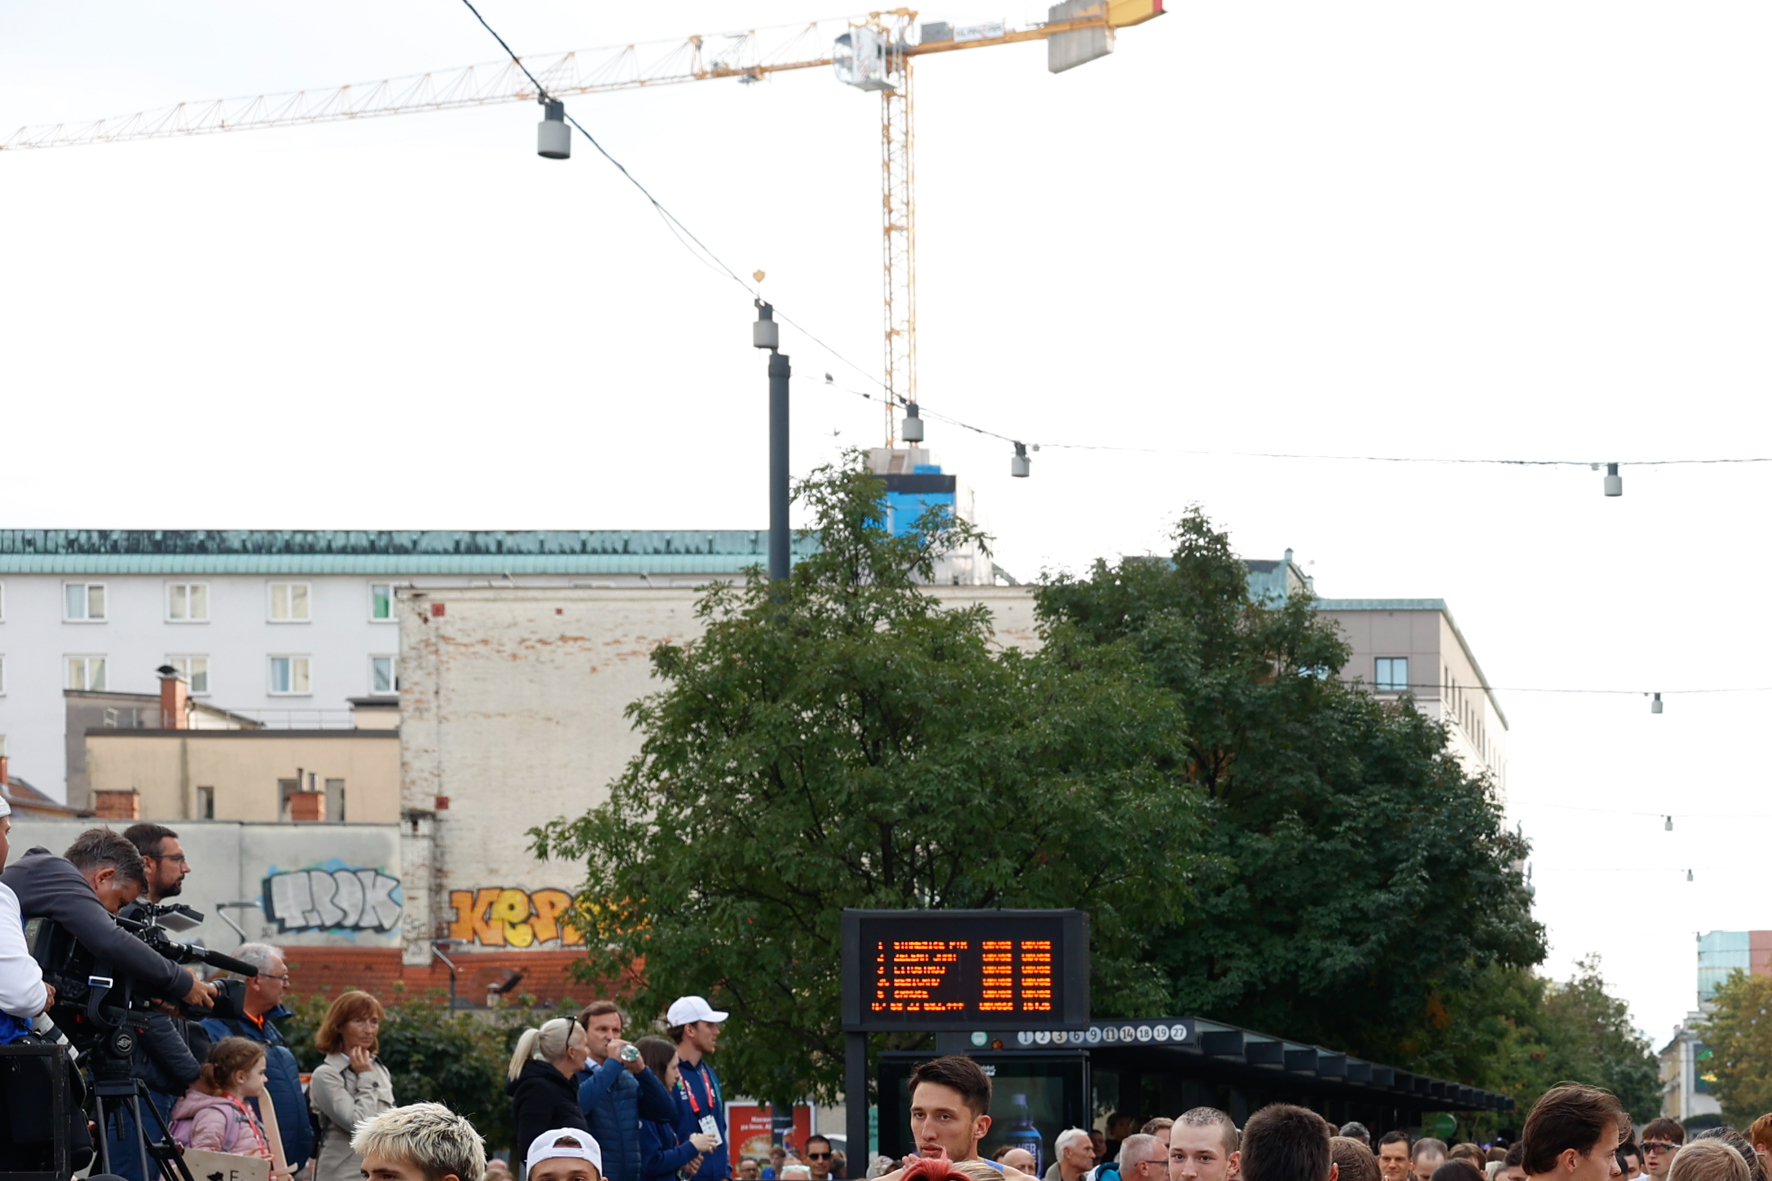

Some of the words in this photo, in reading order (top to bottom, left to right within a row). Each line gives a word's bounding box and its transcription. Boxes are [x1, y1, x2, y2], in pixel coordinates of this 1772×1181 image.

[1091, 1029, 1097, 1040] 9
[1105, 1029, 1116, 1040] 11
[1122, 1028, 1133, 1040] 14
[1139, 1027, 1149, 1039] 18
[1156, 1027, 1167, 1038] 19
[1173, 1026, 1184, 1038] 27
